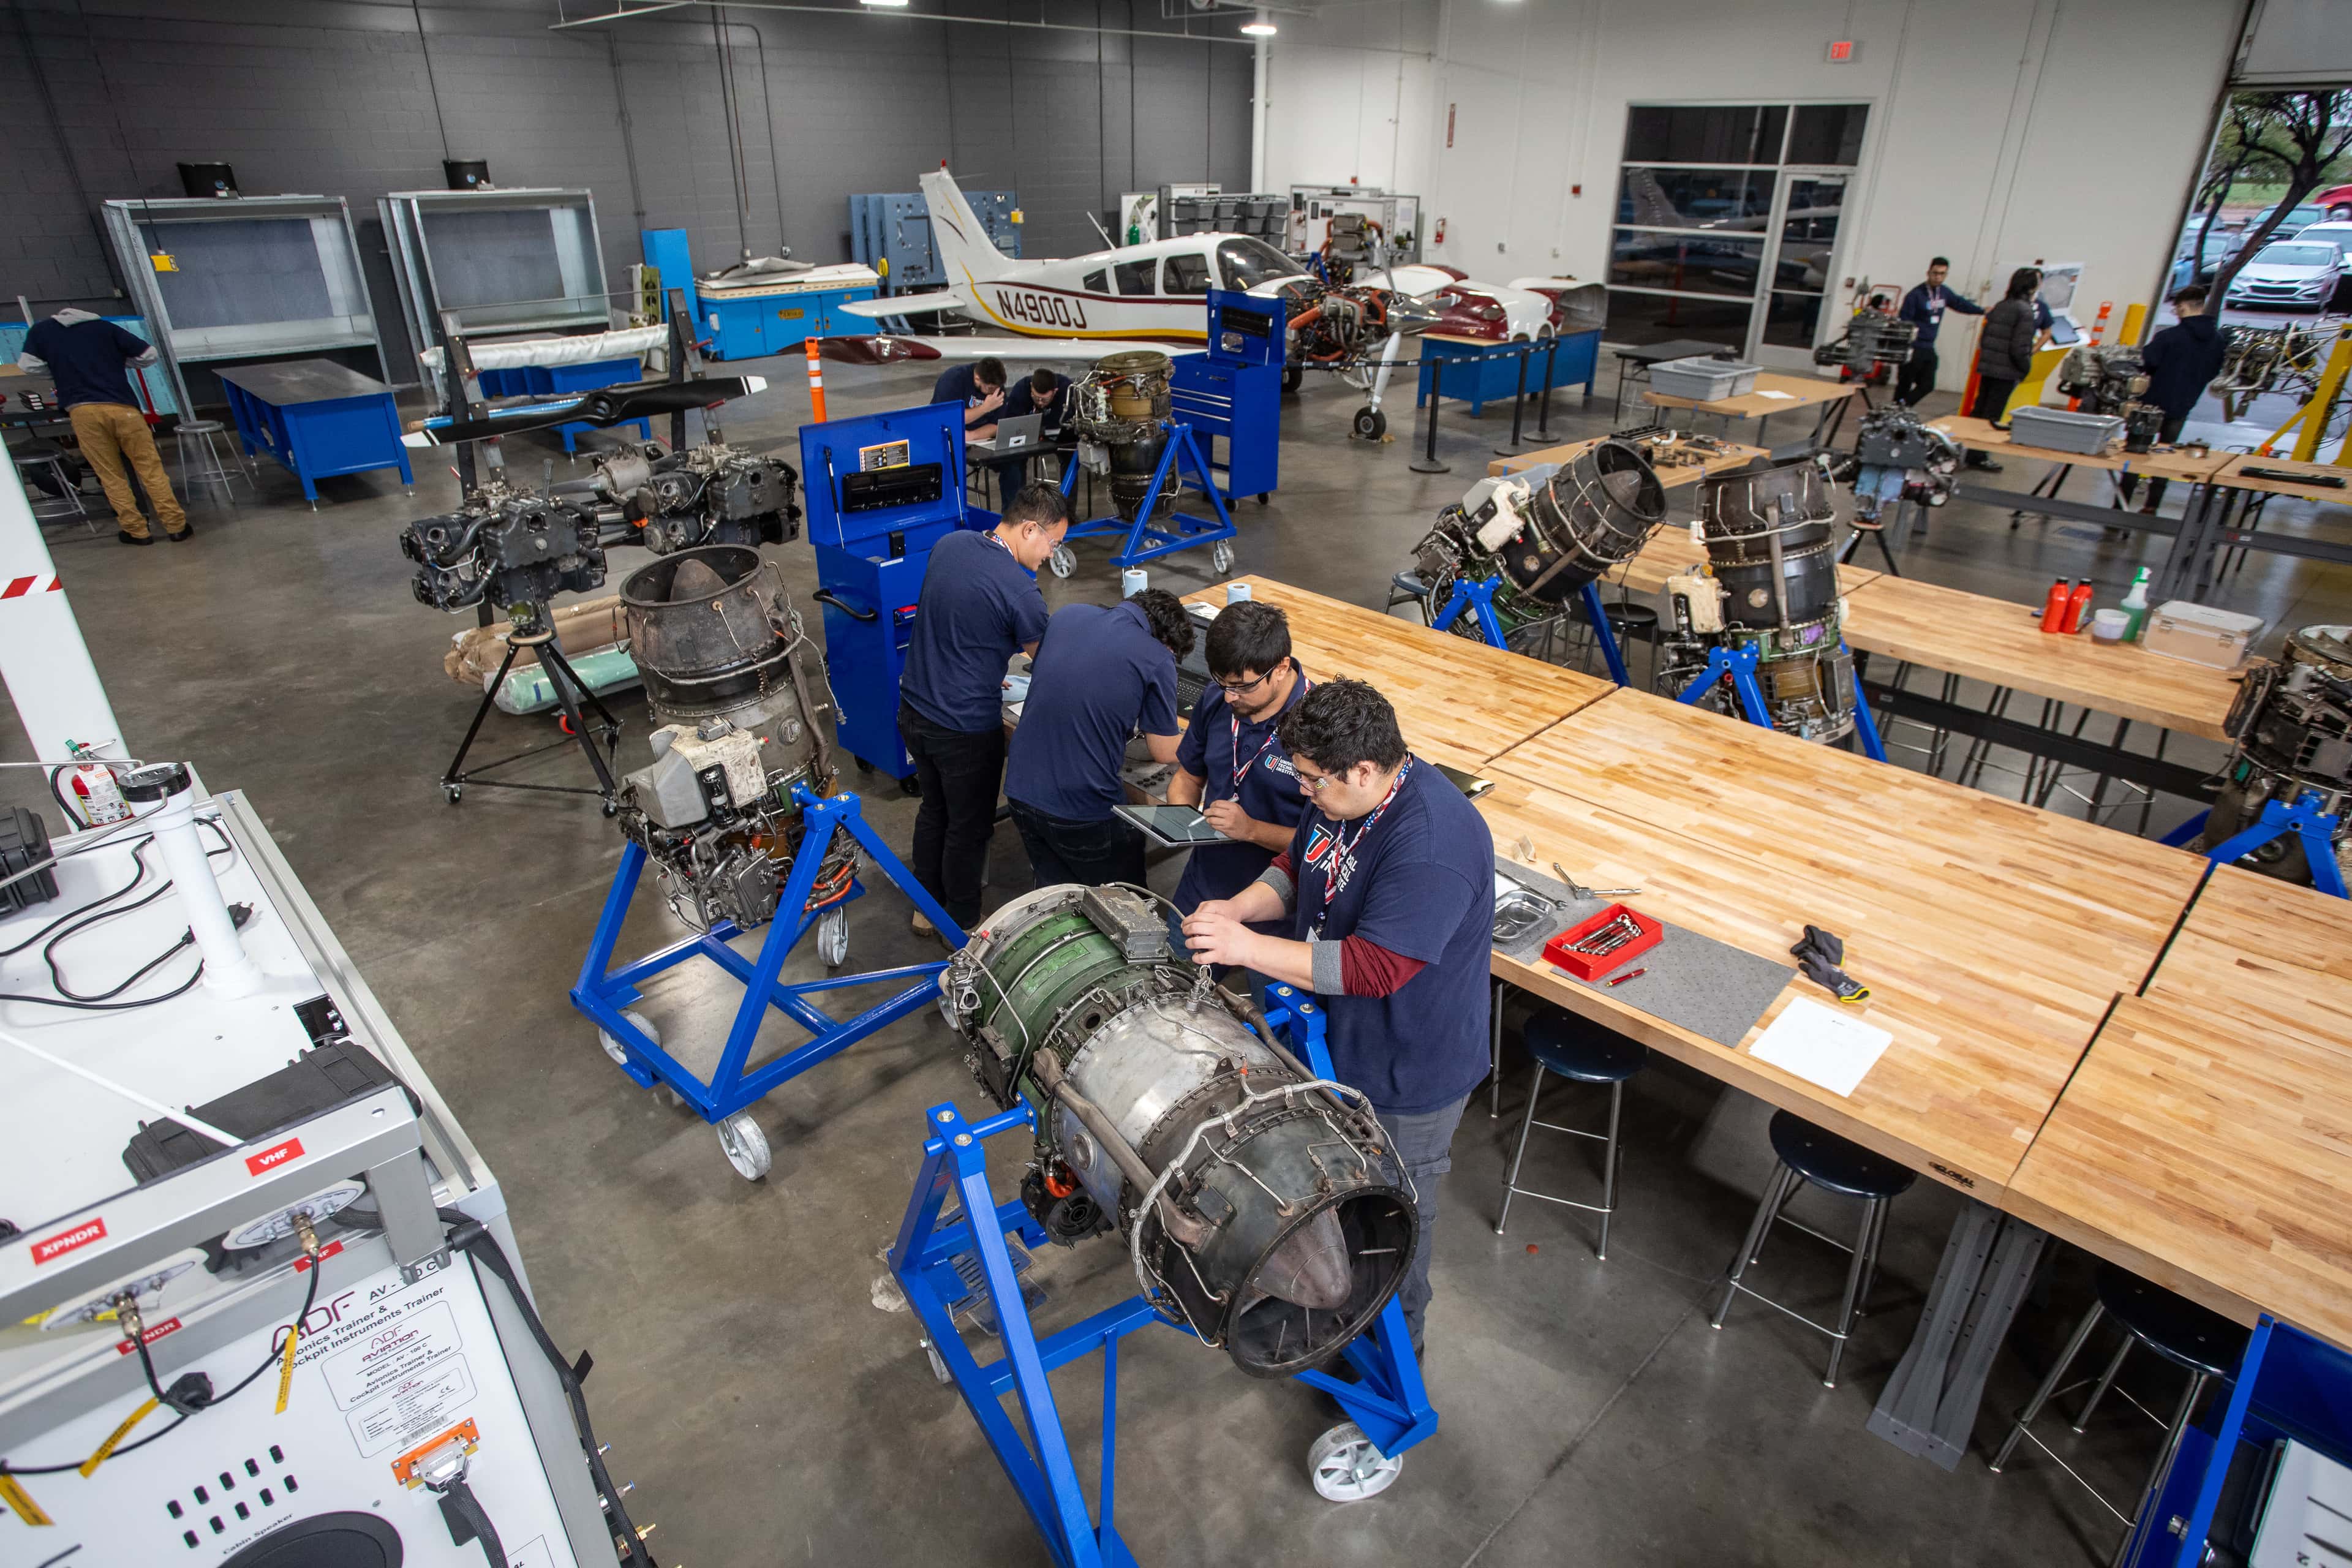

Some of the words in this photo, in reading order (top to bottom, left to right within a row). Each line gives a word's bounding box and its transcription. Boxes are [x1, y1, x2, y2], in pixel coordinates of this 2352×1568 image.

[1831, 42, 1852, 59] EXIT
[997, 290, 1087, 329] N4900J
[258, 1148, 288, 1165] VHF
[40, 1224, 100, 1257] XPNDR
[369, 1284, 387, 1301] AV
[277, 1334, 330, 1365] Aonics
[333, 1310, 375, 1336] Trainer
[377, 1303, 388, 1314] &
[331, 1308, 402, 1349] Instruments
[404, 1287, 444, 1311] Trainer
[126, 1322, 176, 1349] XNDR
[362, 1329, 419, 1362] AVIATION
[371, 1325, 404, 1349] ADF
[350, 1385, 380, 1403] Cockpit
[381, 1360, 425, 1386] Instruments
[426, 1346, 452, 1362] Trainer
[366, 1362, 391, 1377] MODEL
[366, 1369, 399, 1387] Avionics
[399, 1353, 426, 1369] Trainer
[222, 1536, 252, 1555] Cabin
[254, 1513, 292, 1537] Speaker
